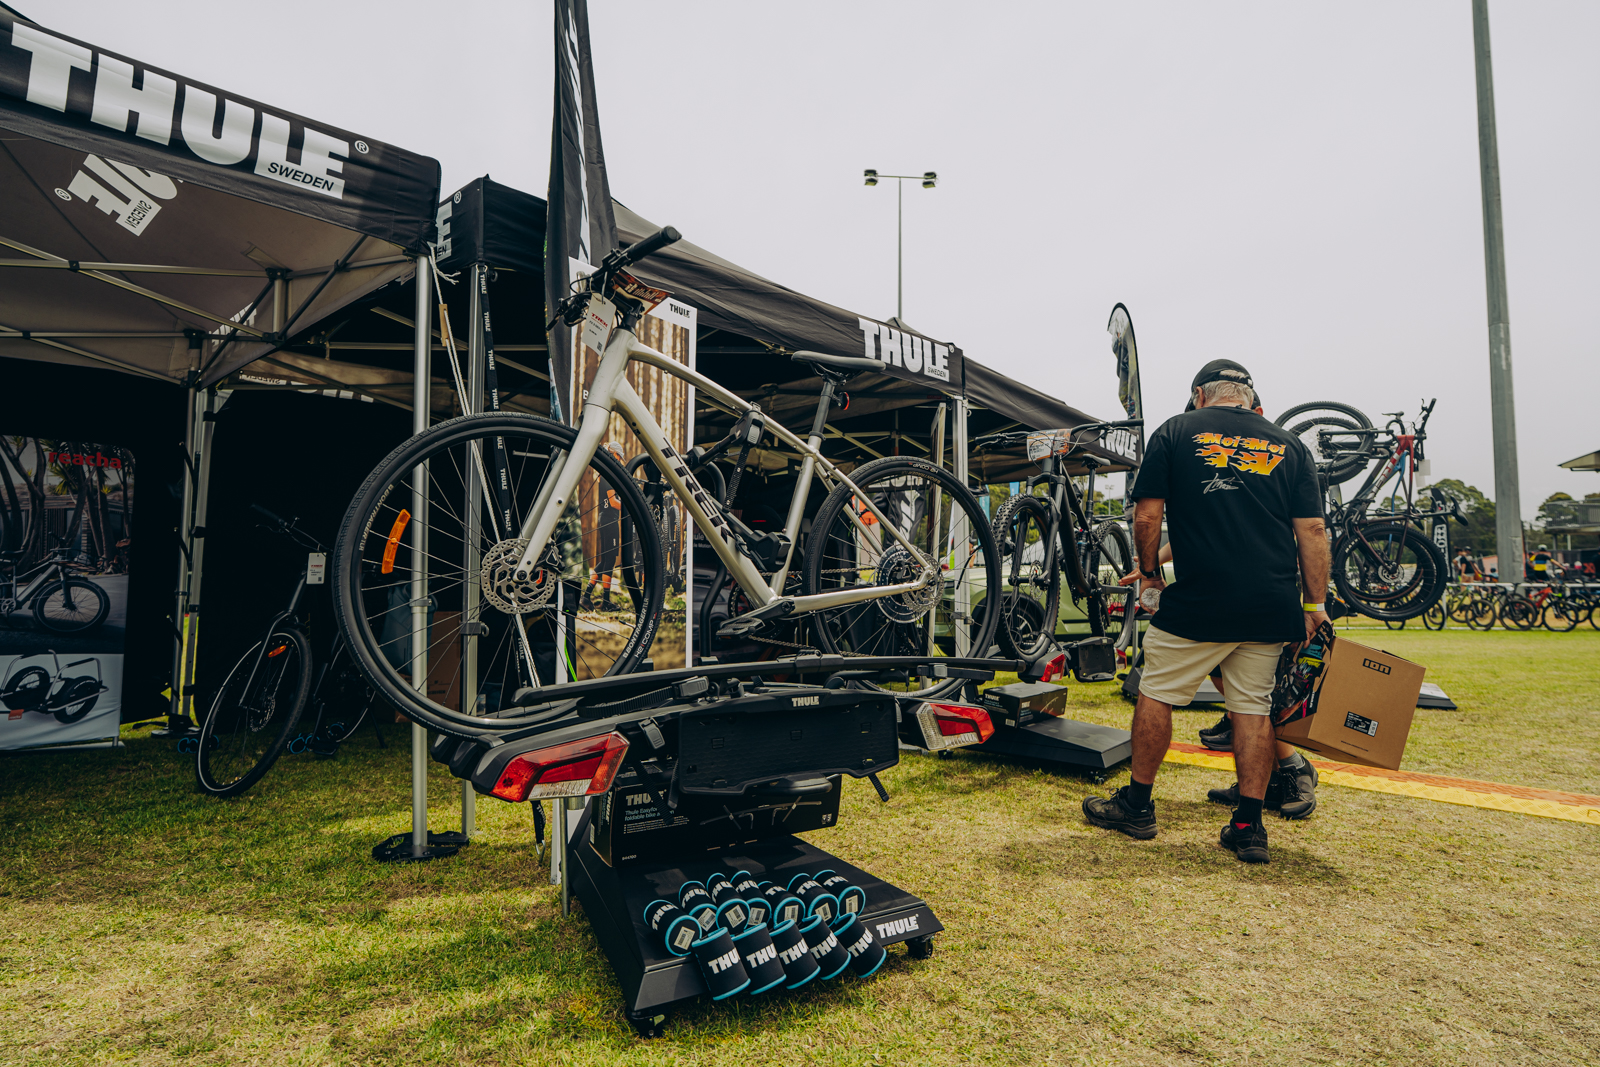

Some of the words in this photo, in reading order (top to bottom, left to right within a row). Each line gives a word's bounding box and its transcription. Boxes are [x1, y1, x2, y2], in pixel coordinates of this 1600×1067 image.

[11, 21, 350, 200] THULE
[267, 161, 335, 193] SWEDEN
[669, 302, 691, 317] THULE
[487, 349, 495, 371] THULE
[857, 317, 950, 383] THULE
[927, 366, 947, 379] SWEDEN
[491, 388, 500, 410] THULE
[1192, 432, 1241, 448] Moi
[1239, 437, 1287, 455] Moi
[48, 452, 122, 469] reacha
[1195, 444, 1285, 476] TV
[499, 468, 509, 490] THULE
[660, 437, 736, 545] TREK
[504, 508, 513, 531] THULE
[641, 619, 654, 645] COMP
[791, 695, 820, 708] THULE
[605, 791, 613, 823] THULE
[645, 811, 657, 819] bike
[876, 914, 919, 939] THULE
[779, 937, 810, 966] THU
[809, 931, 838, 960] THU
[847, 926, 874, 958] THU
[708, 946, 741, 975] THU
[746, 942, 778, 969] THU
